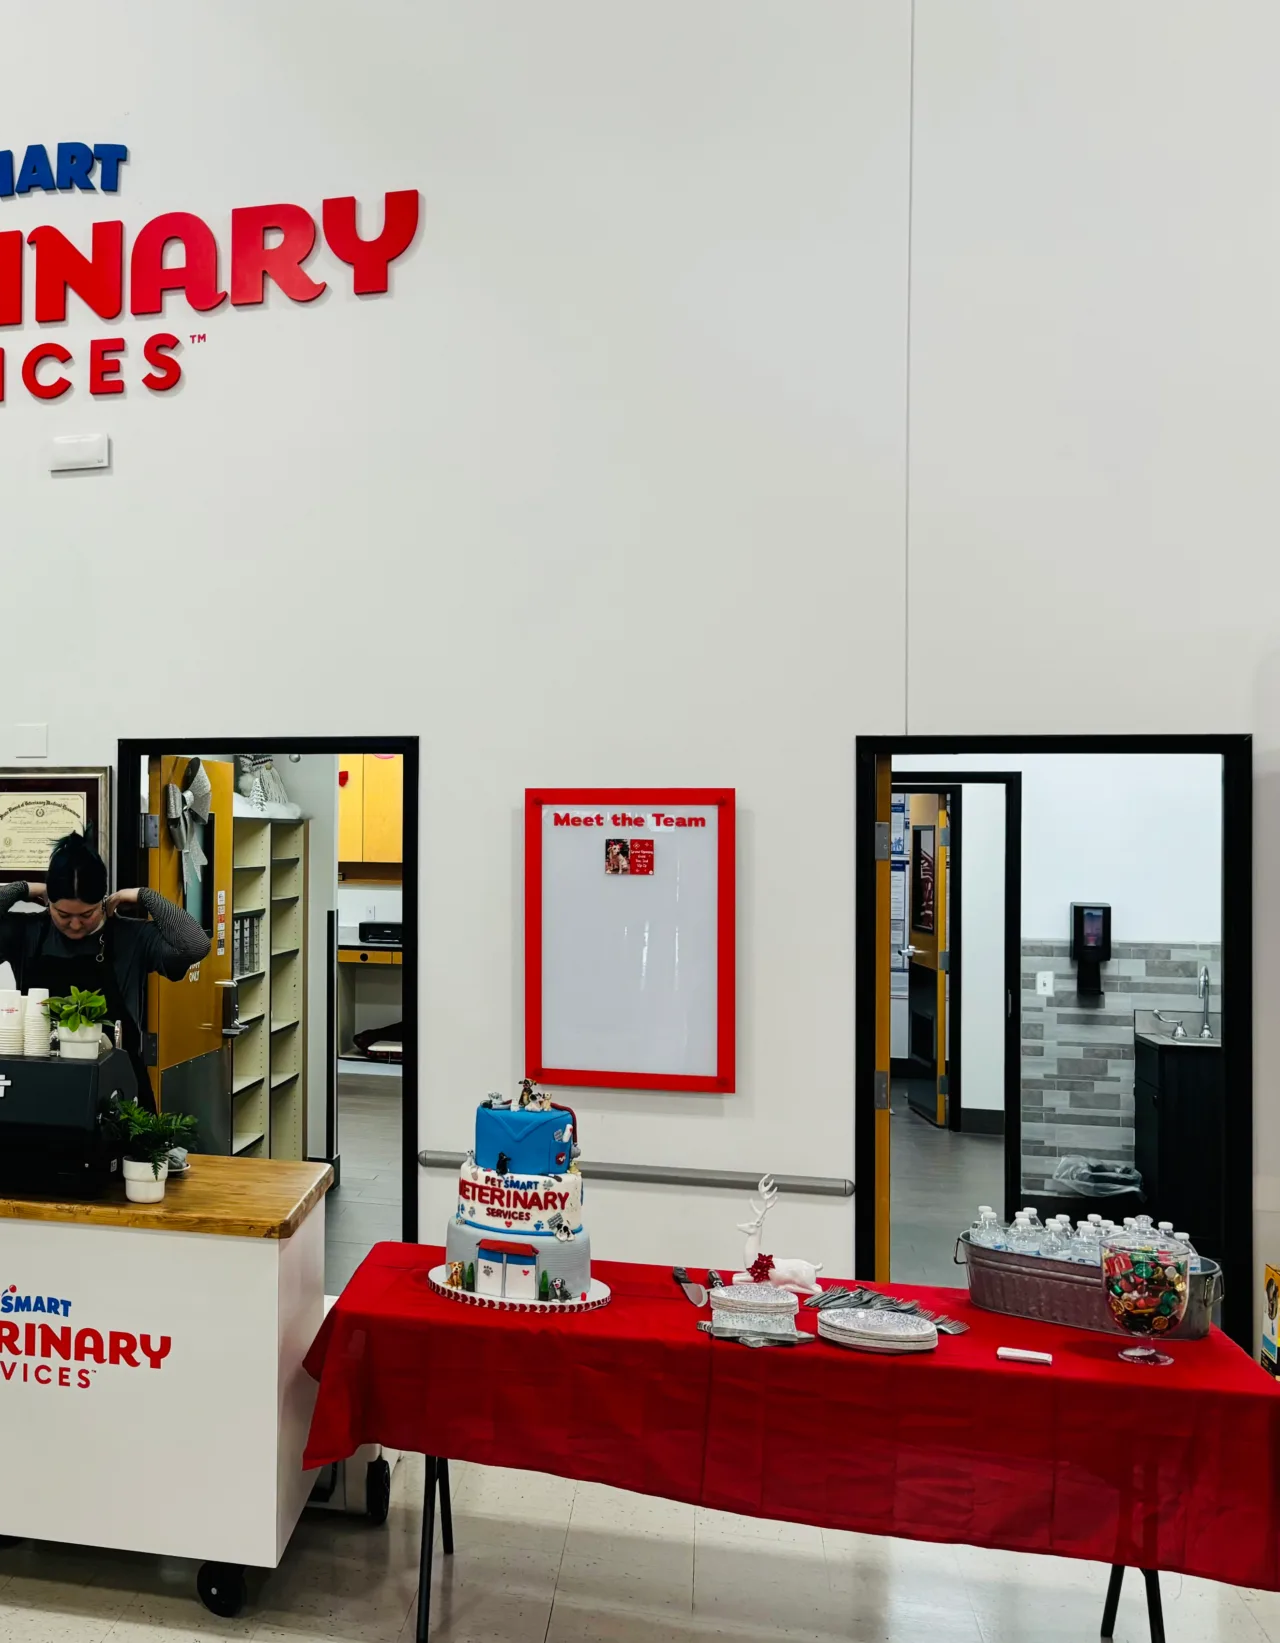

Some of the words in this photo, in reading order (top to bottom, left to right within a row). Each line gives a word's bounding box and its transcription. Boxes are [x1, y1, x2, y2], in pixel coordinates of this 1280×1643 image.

[553, 813, 604, 826] Meet
[611, 813, 645, 827] the
[652, 813, 706, 827] Team
[485, 1175, 539, 1190] PETSMART
[486, 1207, 531, 1221] SERVICES
